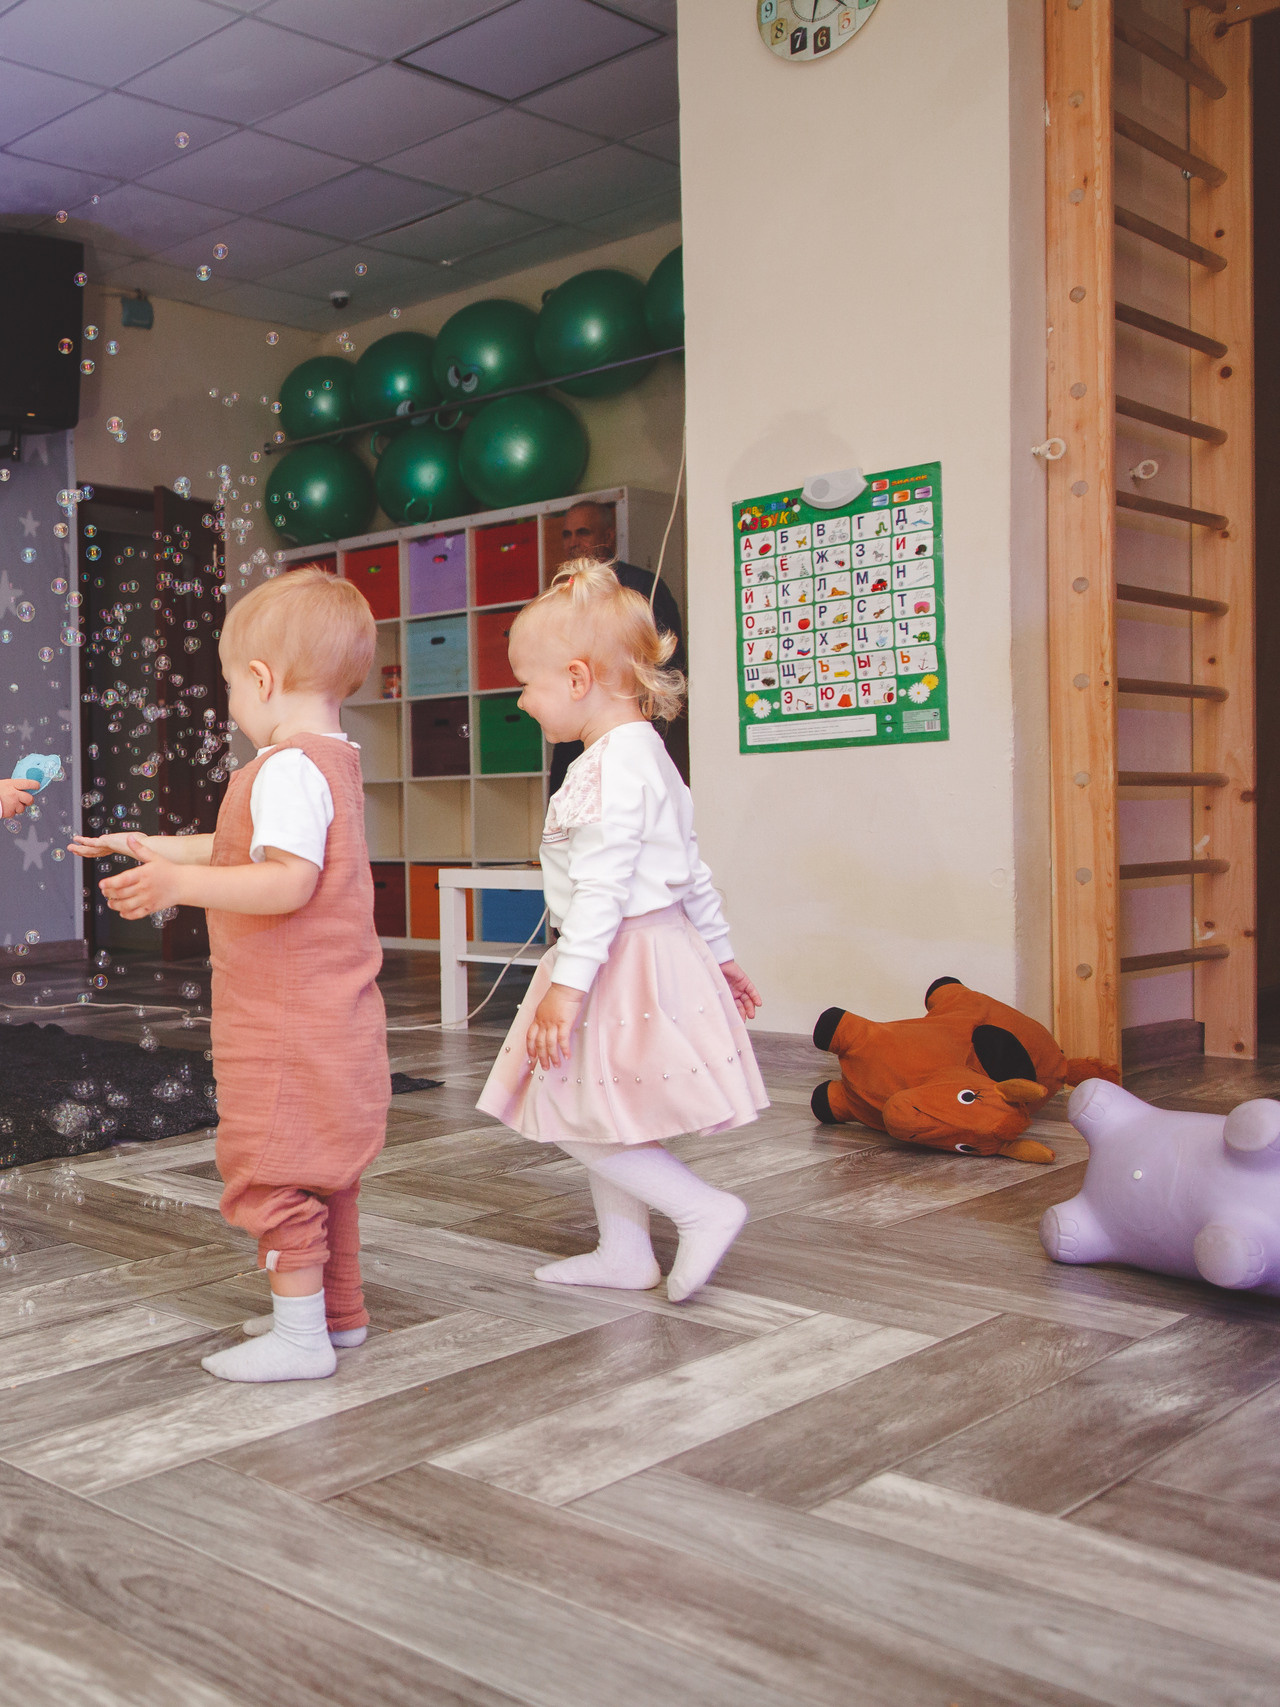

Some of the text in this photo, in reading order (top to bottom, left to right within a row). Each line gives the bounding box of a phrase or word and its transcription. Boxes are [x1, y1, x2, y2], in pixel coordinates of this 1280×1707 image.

[765, 1, 773, 18] 9
[841, 12, 851, 29] 5
[775, 22, 784, 39] 8
[794, 30, 803, 49] 7
[817, 30, 827, 48] 6
[740, 511, 799, 533] АЗБУКА
[744, 538, 752, 550] А
[781, 531, 788, 543] Б
[817, 524, 825, 536] В
[857, 516, 864, 529] Г
[896, 508, 907, 525] Д
[745, 564, 753, 576] Е
[780, 556, 789, 571] Ё
[816, 550, 828, 564] Ж
[856, 544, 865, 557] З
[896, 537, 905, 550] И
[745, 589, 753, 604] Й
[782, 584, 790, 596] К
[817, 578, 826, 591] Л
[857, 571, 868, 584] М
[897, 565, 905, 578] Н
[746, 616, 755, 628] О
[783, 611, 791, 623] П
[819, 606, 827, 618] Р
[857, 600, 866, 612] С
[897, 594, 907, 607] Т
[747, 642, 754, 655] У
[782, 637, 794, 650] Ф
[819, 632, 828, 645] Х
[857, 627, 868, 642] Ц
[899, 622, 908, 635] Ч
[746, 668, 759, 681] Ш
[782, 664, 796, 678] Щ
[818, 660, 829, 672] Ъ
[857, 655, 871, 668] Ы
[900, 651, 910, 663] Ь
[784, 691, 792, 704] Э
[821, 687, 834, 700] Ю
[861, 683, 870, 696] Я
